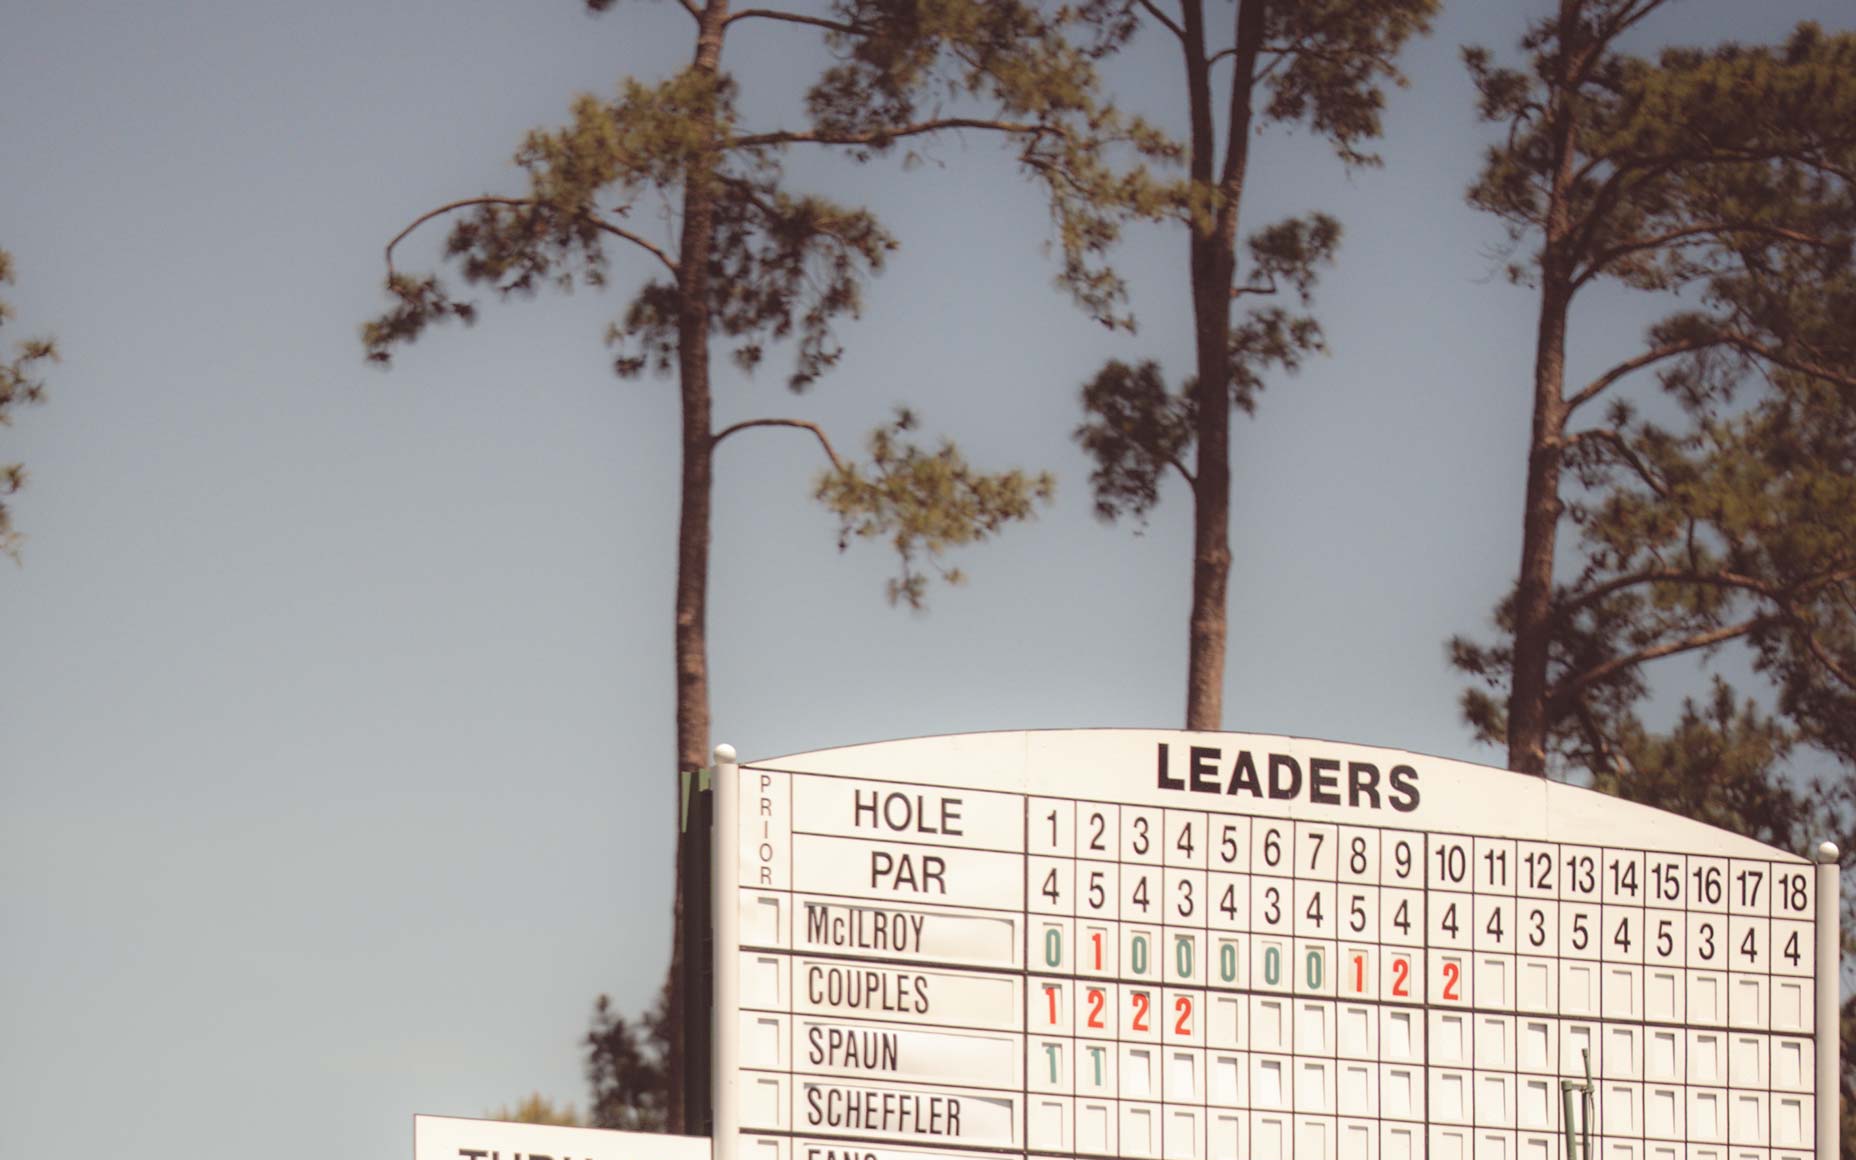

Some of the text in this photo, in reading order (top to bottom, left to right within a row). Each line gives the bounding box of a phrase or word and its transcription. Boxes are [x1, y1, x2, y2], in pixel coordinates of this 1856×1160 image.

[1157, 743, 1421, 813] LEADERS
[759, 774, 774, 885] PRIOR
[854, 788, 1808, 912] HOLE 1 2 3 4 5 6 7 8 9 10 11 12 13 14 15 16 17 18
[870, 850, 1801, 967] PAR 4 5 4 3 4 3 4 5 4 4 4 3 5 4 5 3 4 4
[806, 905, 1460, 1001] McILROY 0 1 0 0 0 0 0 1 2 2
[808, 966, 1192, 1036] COUPLES 1 2 2 2
[808, 1026, 1102, 1086] SPAUN 1 1
[806, 1086, 961, 1137] SCHEFFLER
